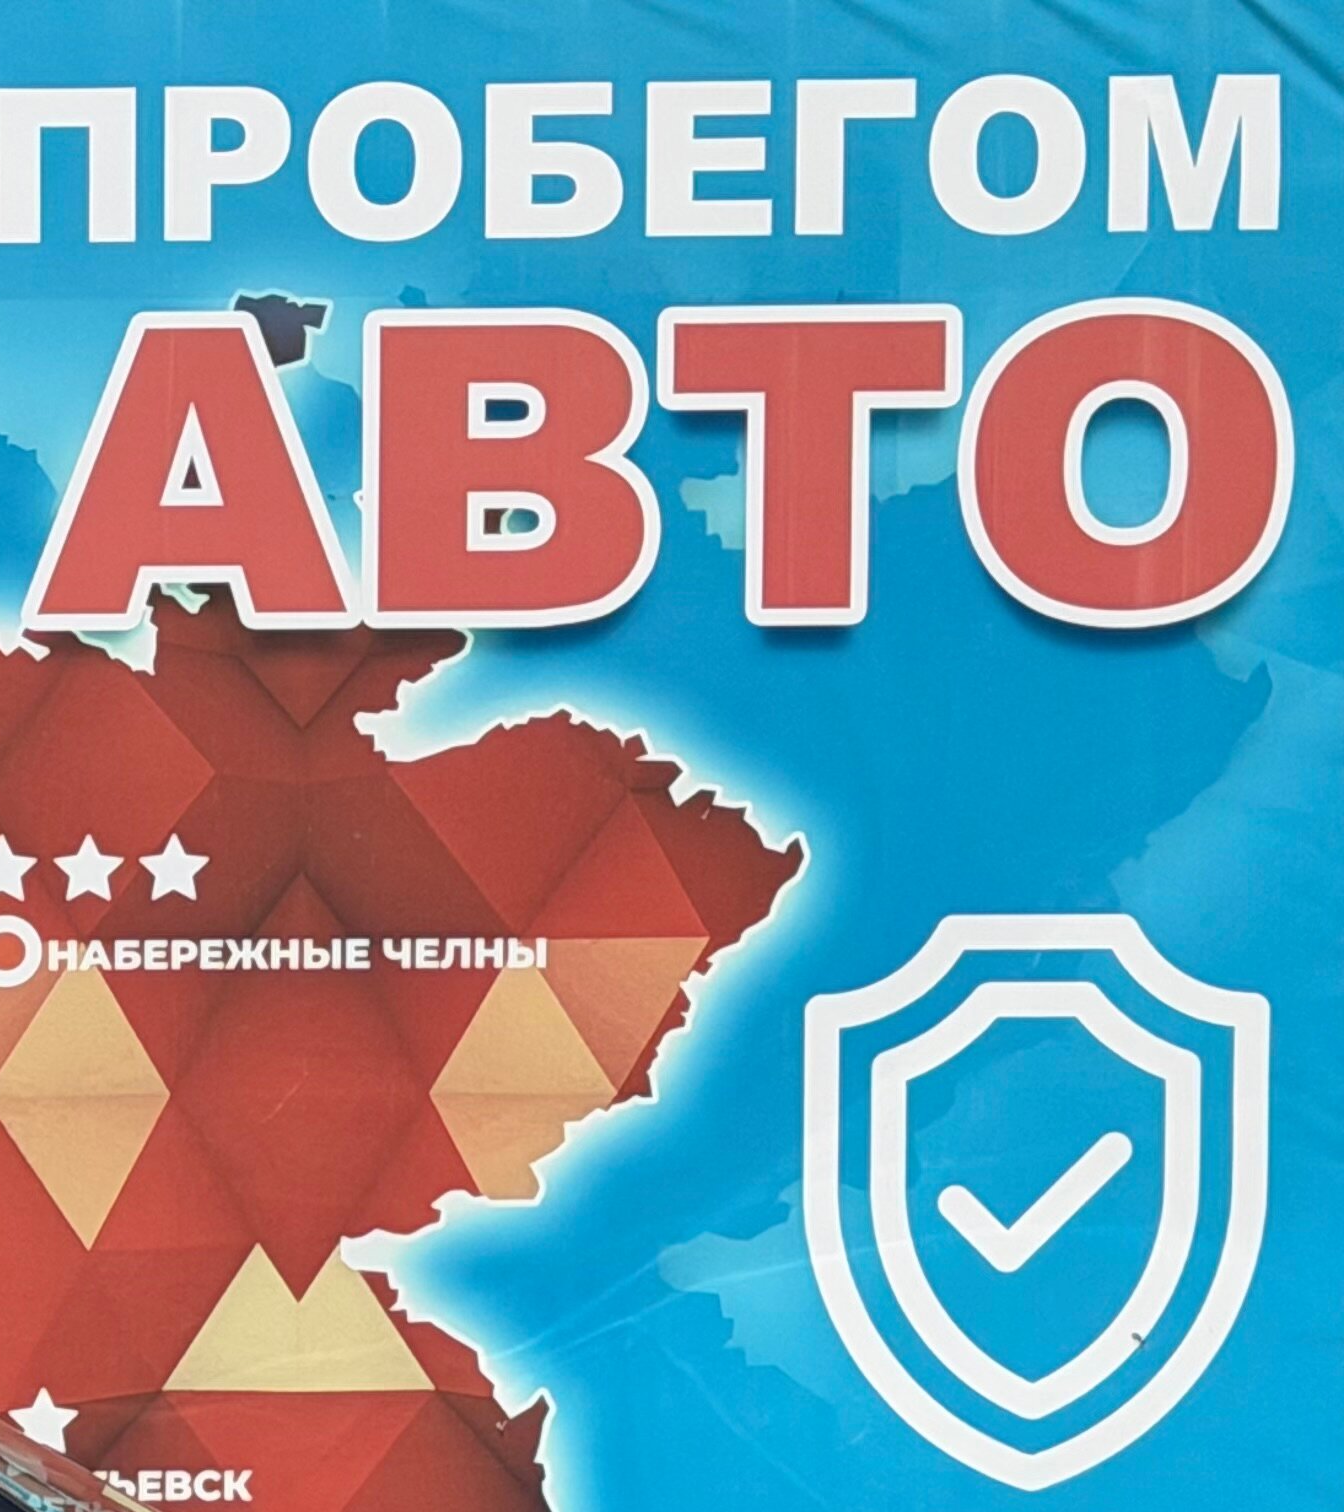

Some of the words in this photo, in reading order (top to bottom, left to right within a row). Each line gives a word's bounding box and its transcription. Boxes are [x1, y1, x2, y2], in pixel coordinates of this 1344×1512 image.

[20, 297, 1296, 628] АВТО
[48, 937, 371, 972] НАБЕРЕЖНЫЕ
[382, 937, 548, 969] ЧЕЛНЫ
[92, 1469, 253, 1502] ЬЕВСК
